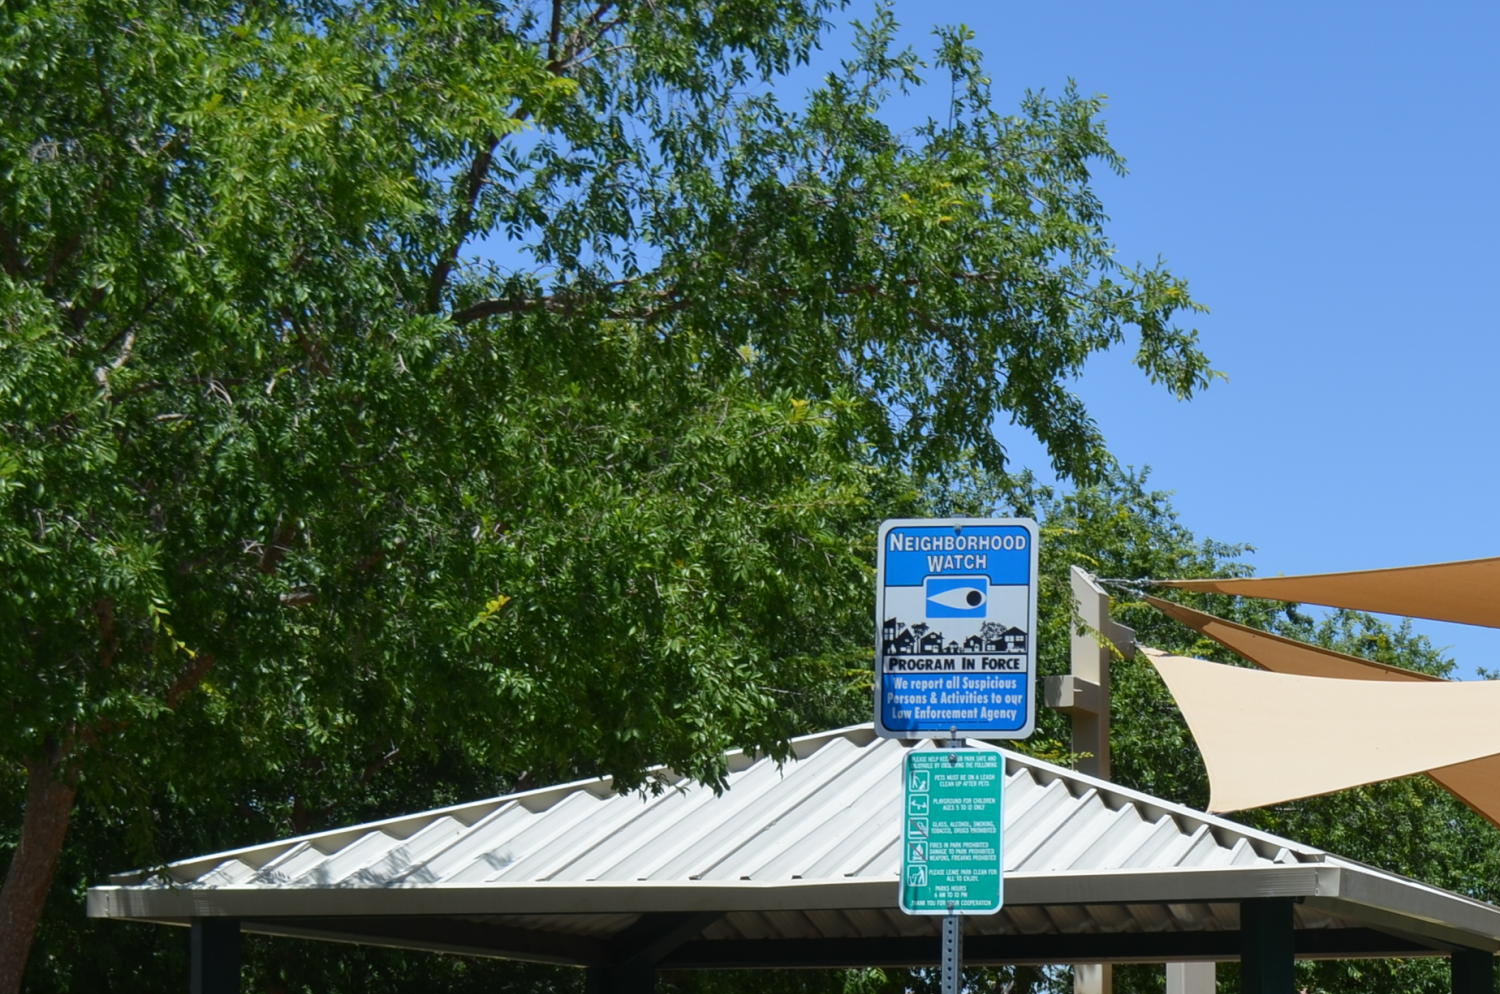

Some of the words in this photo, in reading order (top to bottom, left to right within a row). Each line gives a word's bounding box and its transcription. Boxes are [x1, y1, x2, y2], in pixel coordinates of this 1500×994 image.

[889, 533, 1026, 551] NEIGHBORHOOD
[927, 554, 987, 572] WATCH
[889, 657, 955, 670] PROGRAM
[961, 657, 975, 670] IN
[982, 657, 1020, 670] FORCE
[893, 677, 908, 690] We
[911, 677, 944, 691] report
[946, 676, 960, 689] all
[962, 676, 1017, 691] Suspicious
[887, 692, 927, 704] Persons
[929, 691, 938, 704] &
[940, 691, 989, 704] Activities
[991, 691, 1001, 704] to
[892, 707, 912, 719] Law
[914, 706, 978, 719] Enforcement
[980, 707, 1017, 722] Agency
